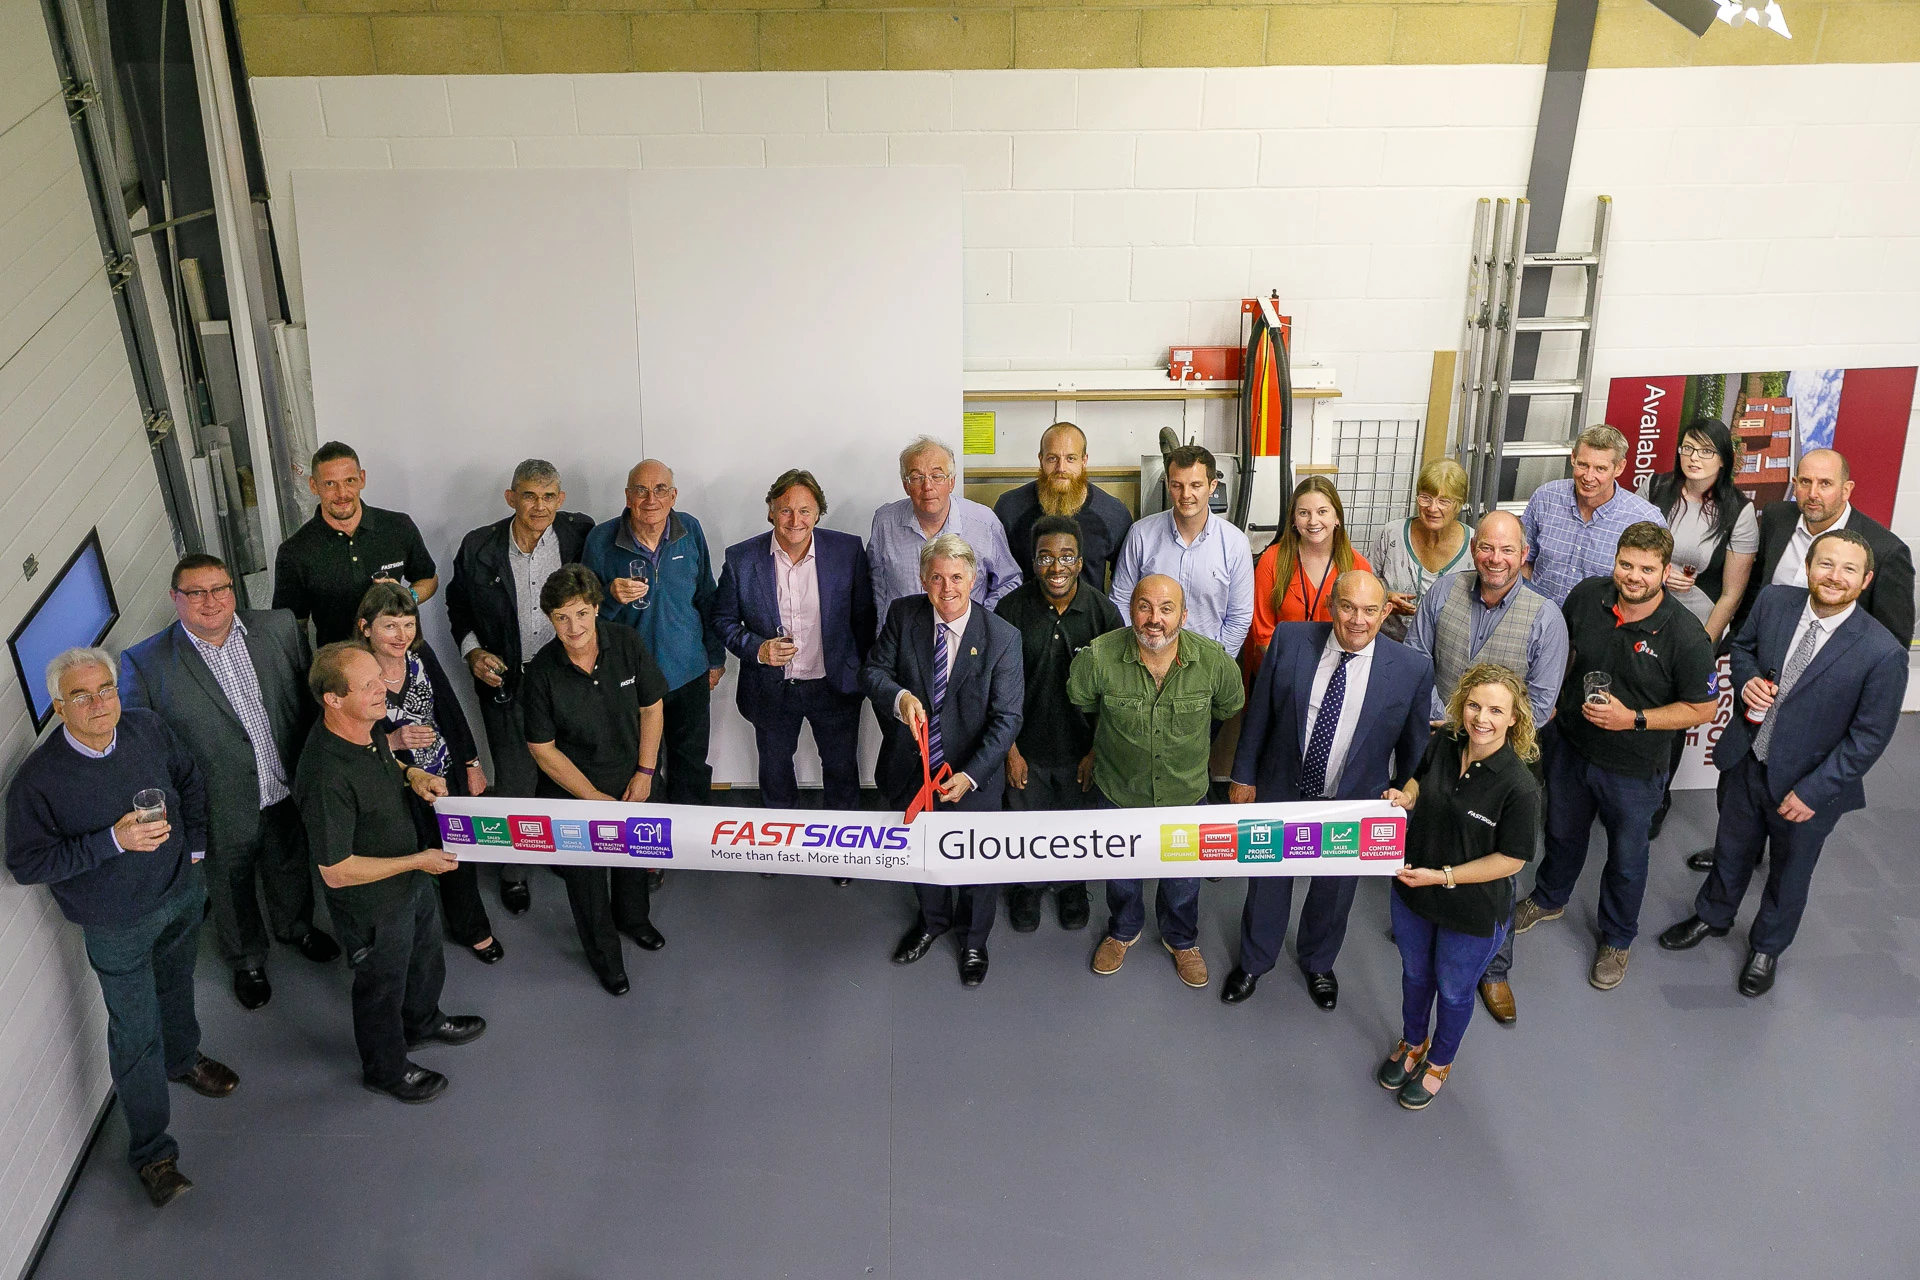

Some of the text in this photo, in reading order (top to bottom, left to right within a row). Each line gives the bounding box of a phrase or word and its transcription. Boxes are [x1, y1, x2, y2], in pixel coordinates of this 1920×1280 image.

[1633, 384, 1666, 488] Available
[1704, 653, 1733, 766] LOSSOM
[711, 820, 910, 849] FASTSIGNS
[938, 828, 1142, 860] Gloucester
[711, 850, 909, 868] More than fast. More than signs.
